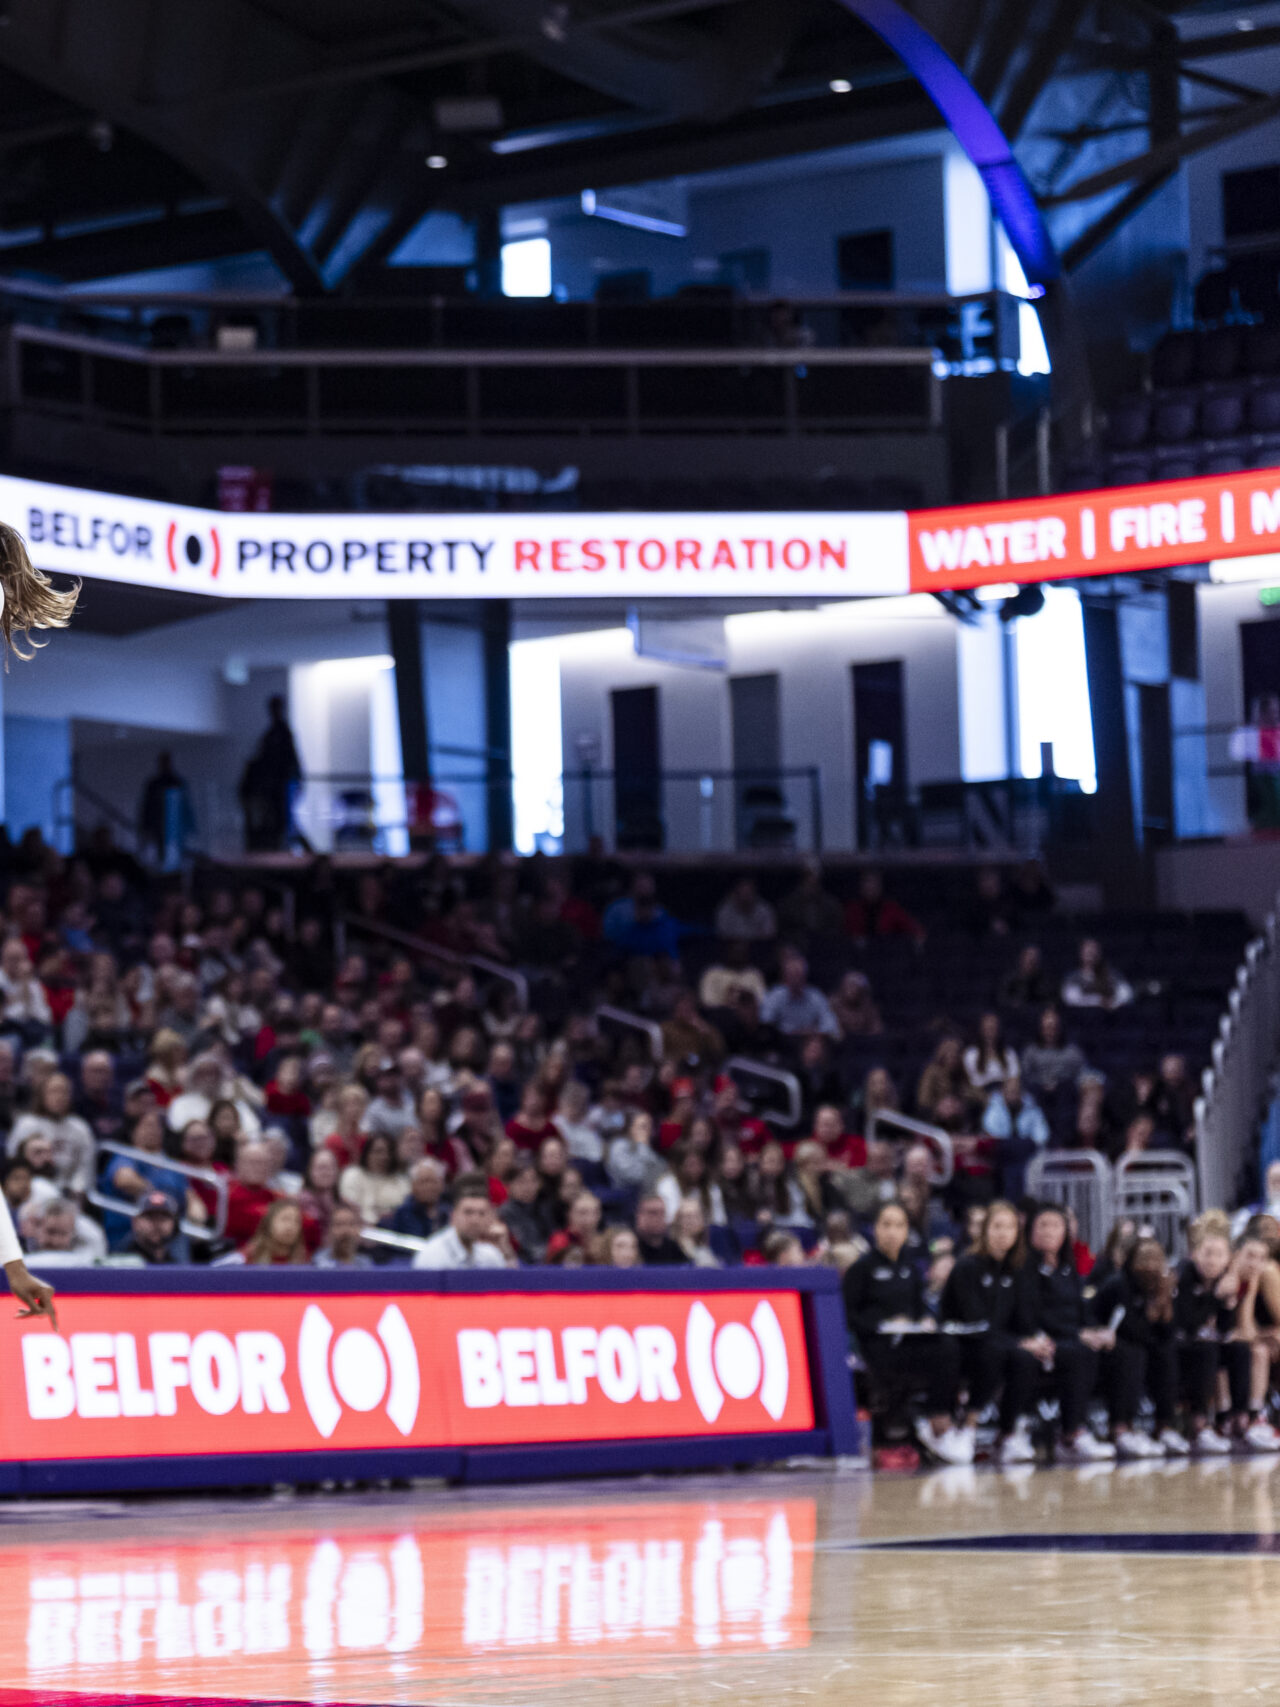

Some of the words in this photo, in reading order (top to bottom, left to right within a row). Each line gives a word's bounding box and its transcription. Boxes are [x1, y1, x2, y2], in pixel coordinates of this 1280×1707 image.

[28, 507, 153, 558] BELFOR
[237, 539, 495, 573] PROPERTY
[513, 539, 848, 573] RESTORATION
[919, 515, 1066, 572] WATER
[1109, 498, 1207, 552] FIRE
[21, 1330, 290, 1420] BELFOR
[456, 1325, 682, 1409] BELFOR
